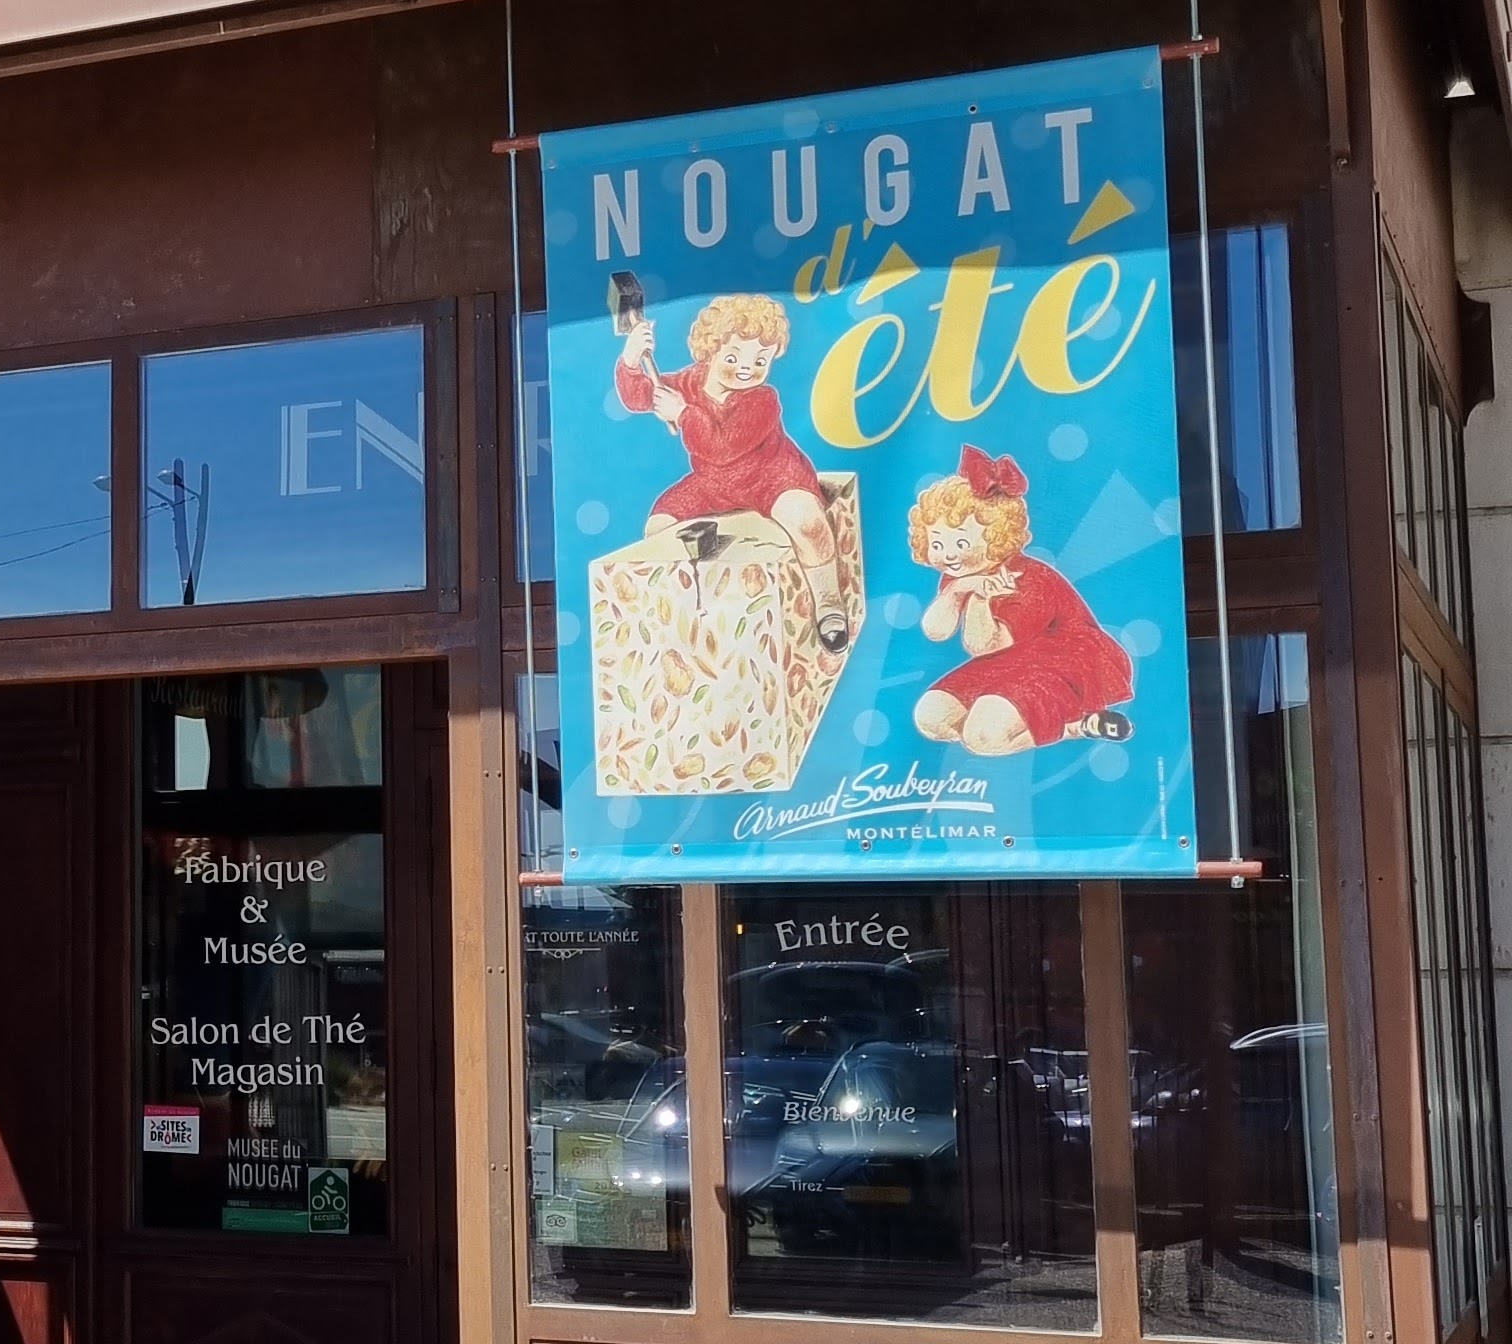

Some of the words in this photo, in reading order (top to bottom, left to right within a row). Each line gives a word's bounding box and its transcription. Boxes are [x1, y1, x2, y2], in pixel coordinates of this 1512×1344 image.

[592, 107, 1094, 262] NOUGAT
[846, 823, 997, 840] MONTÉLIMAR
[184, 854, 327, 890] Fabrique
[240, 895, 269, 924] &
[541, 931, 585, 943] TOUTE
[588, 927, 639, 943] L'ANNÉE
[774, 912, 910, 952] Entrée
[203, 933, 308, 965] Musée
[150, 1016, 240, 1045] Salon
[250, 1015, 293, 1045] de
[301, 1012, 367, 1045] Thé
[190, 1055, 326, 1094] Magasin
[160, 1119, 187, 1132] SITES
[783, 1100, 916, 1124] Bienenue
[227, 1137, 280, 1159] MUSEE
[282, 1140, 302, 1159] du
[227, 1162, 303, 1191] NOUGAT
[789, 1179, 824, 1193] Tirez
